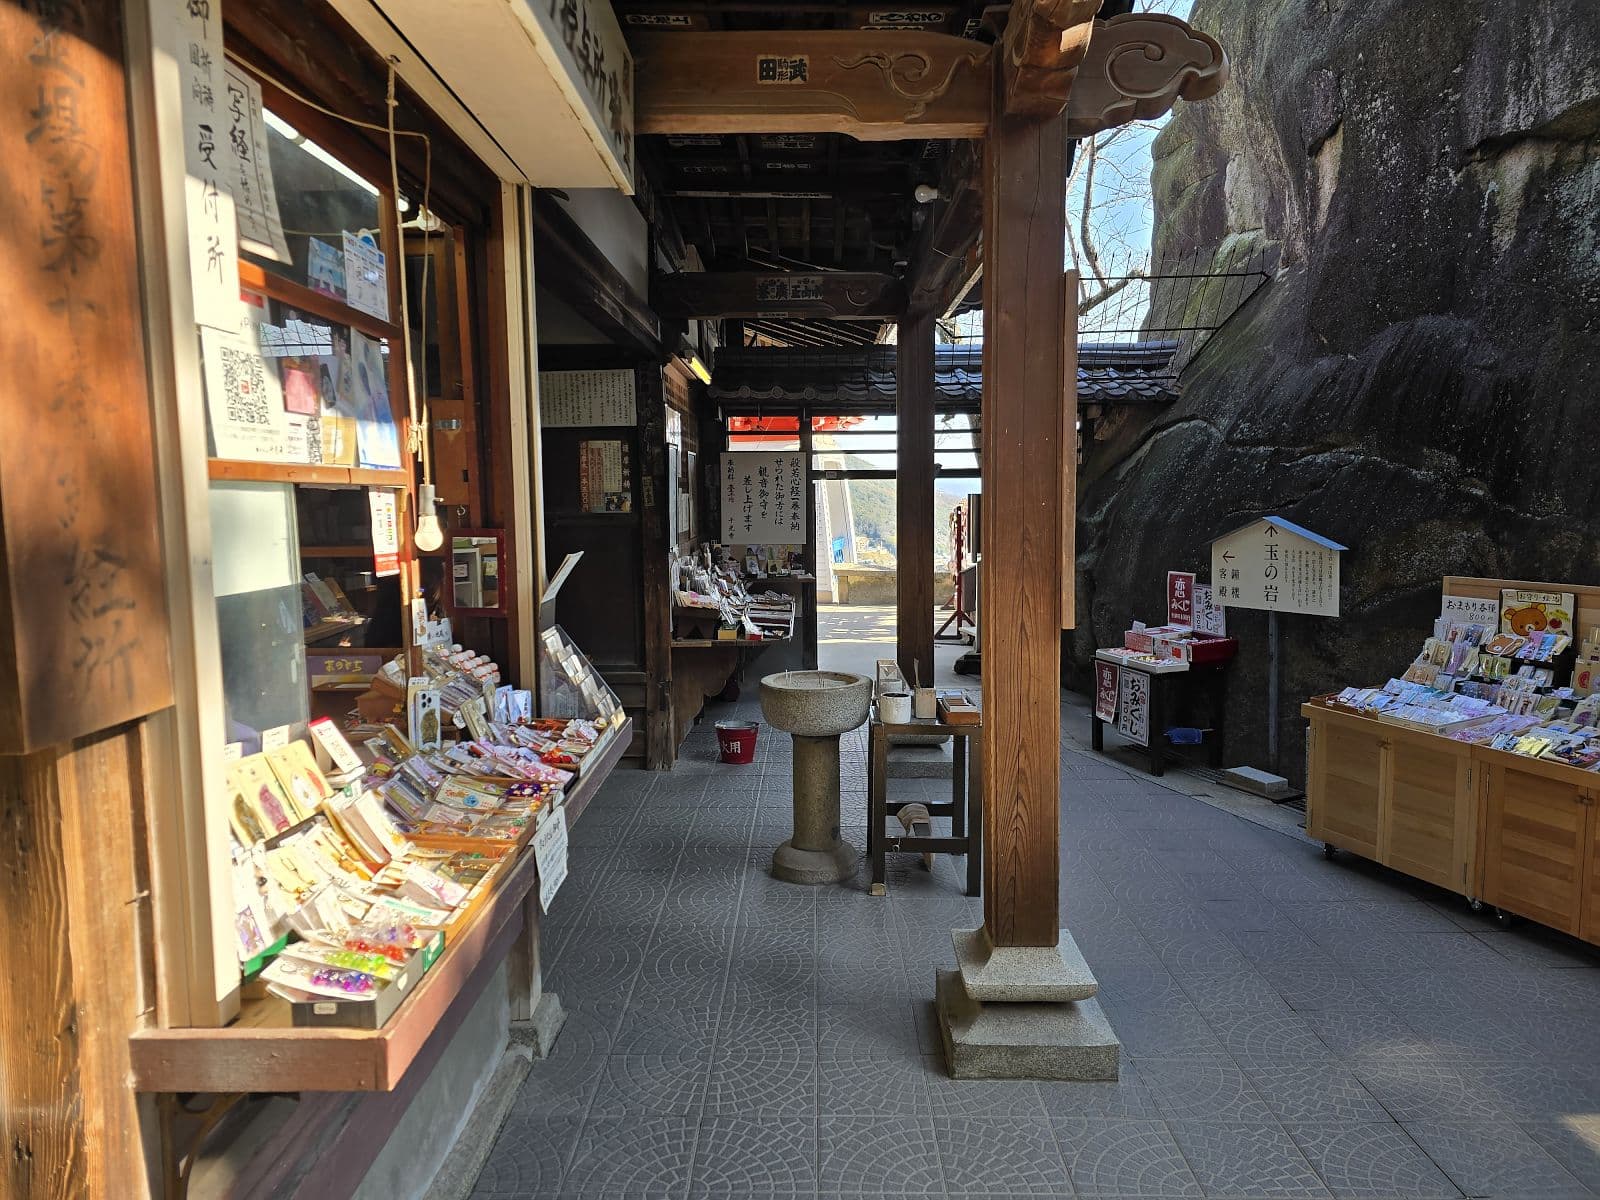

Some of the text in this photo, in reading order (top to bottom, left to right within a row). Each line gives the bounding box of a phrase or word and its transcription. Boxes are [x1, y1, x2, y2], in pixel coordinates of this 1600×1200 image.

[227, 83, 251, 163] 写経
[198, 123, 225, 285] 受付所
[1264, 543, 1279, 603] 玉の岩
[1204, 589, 1213, 631] おみくじ
[1446, 599, 1497, 615] おまもり各種
[1129, 676, 1140, 736] おみくじ
